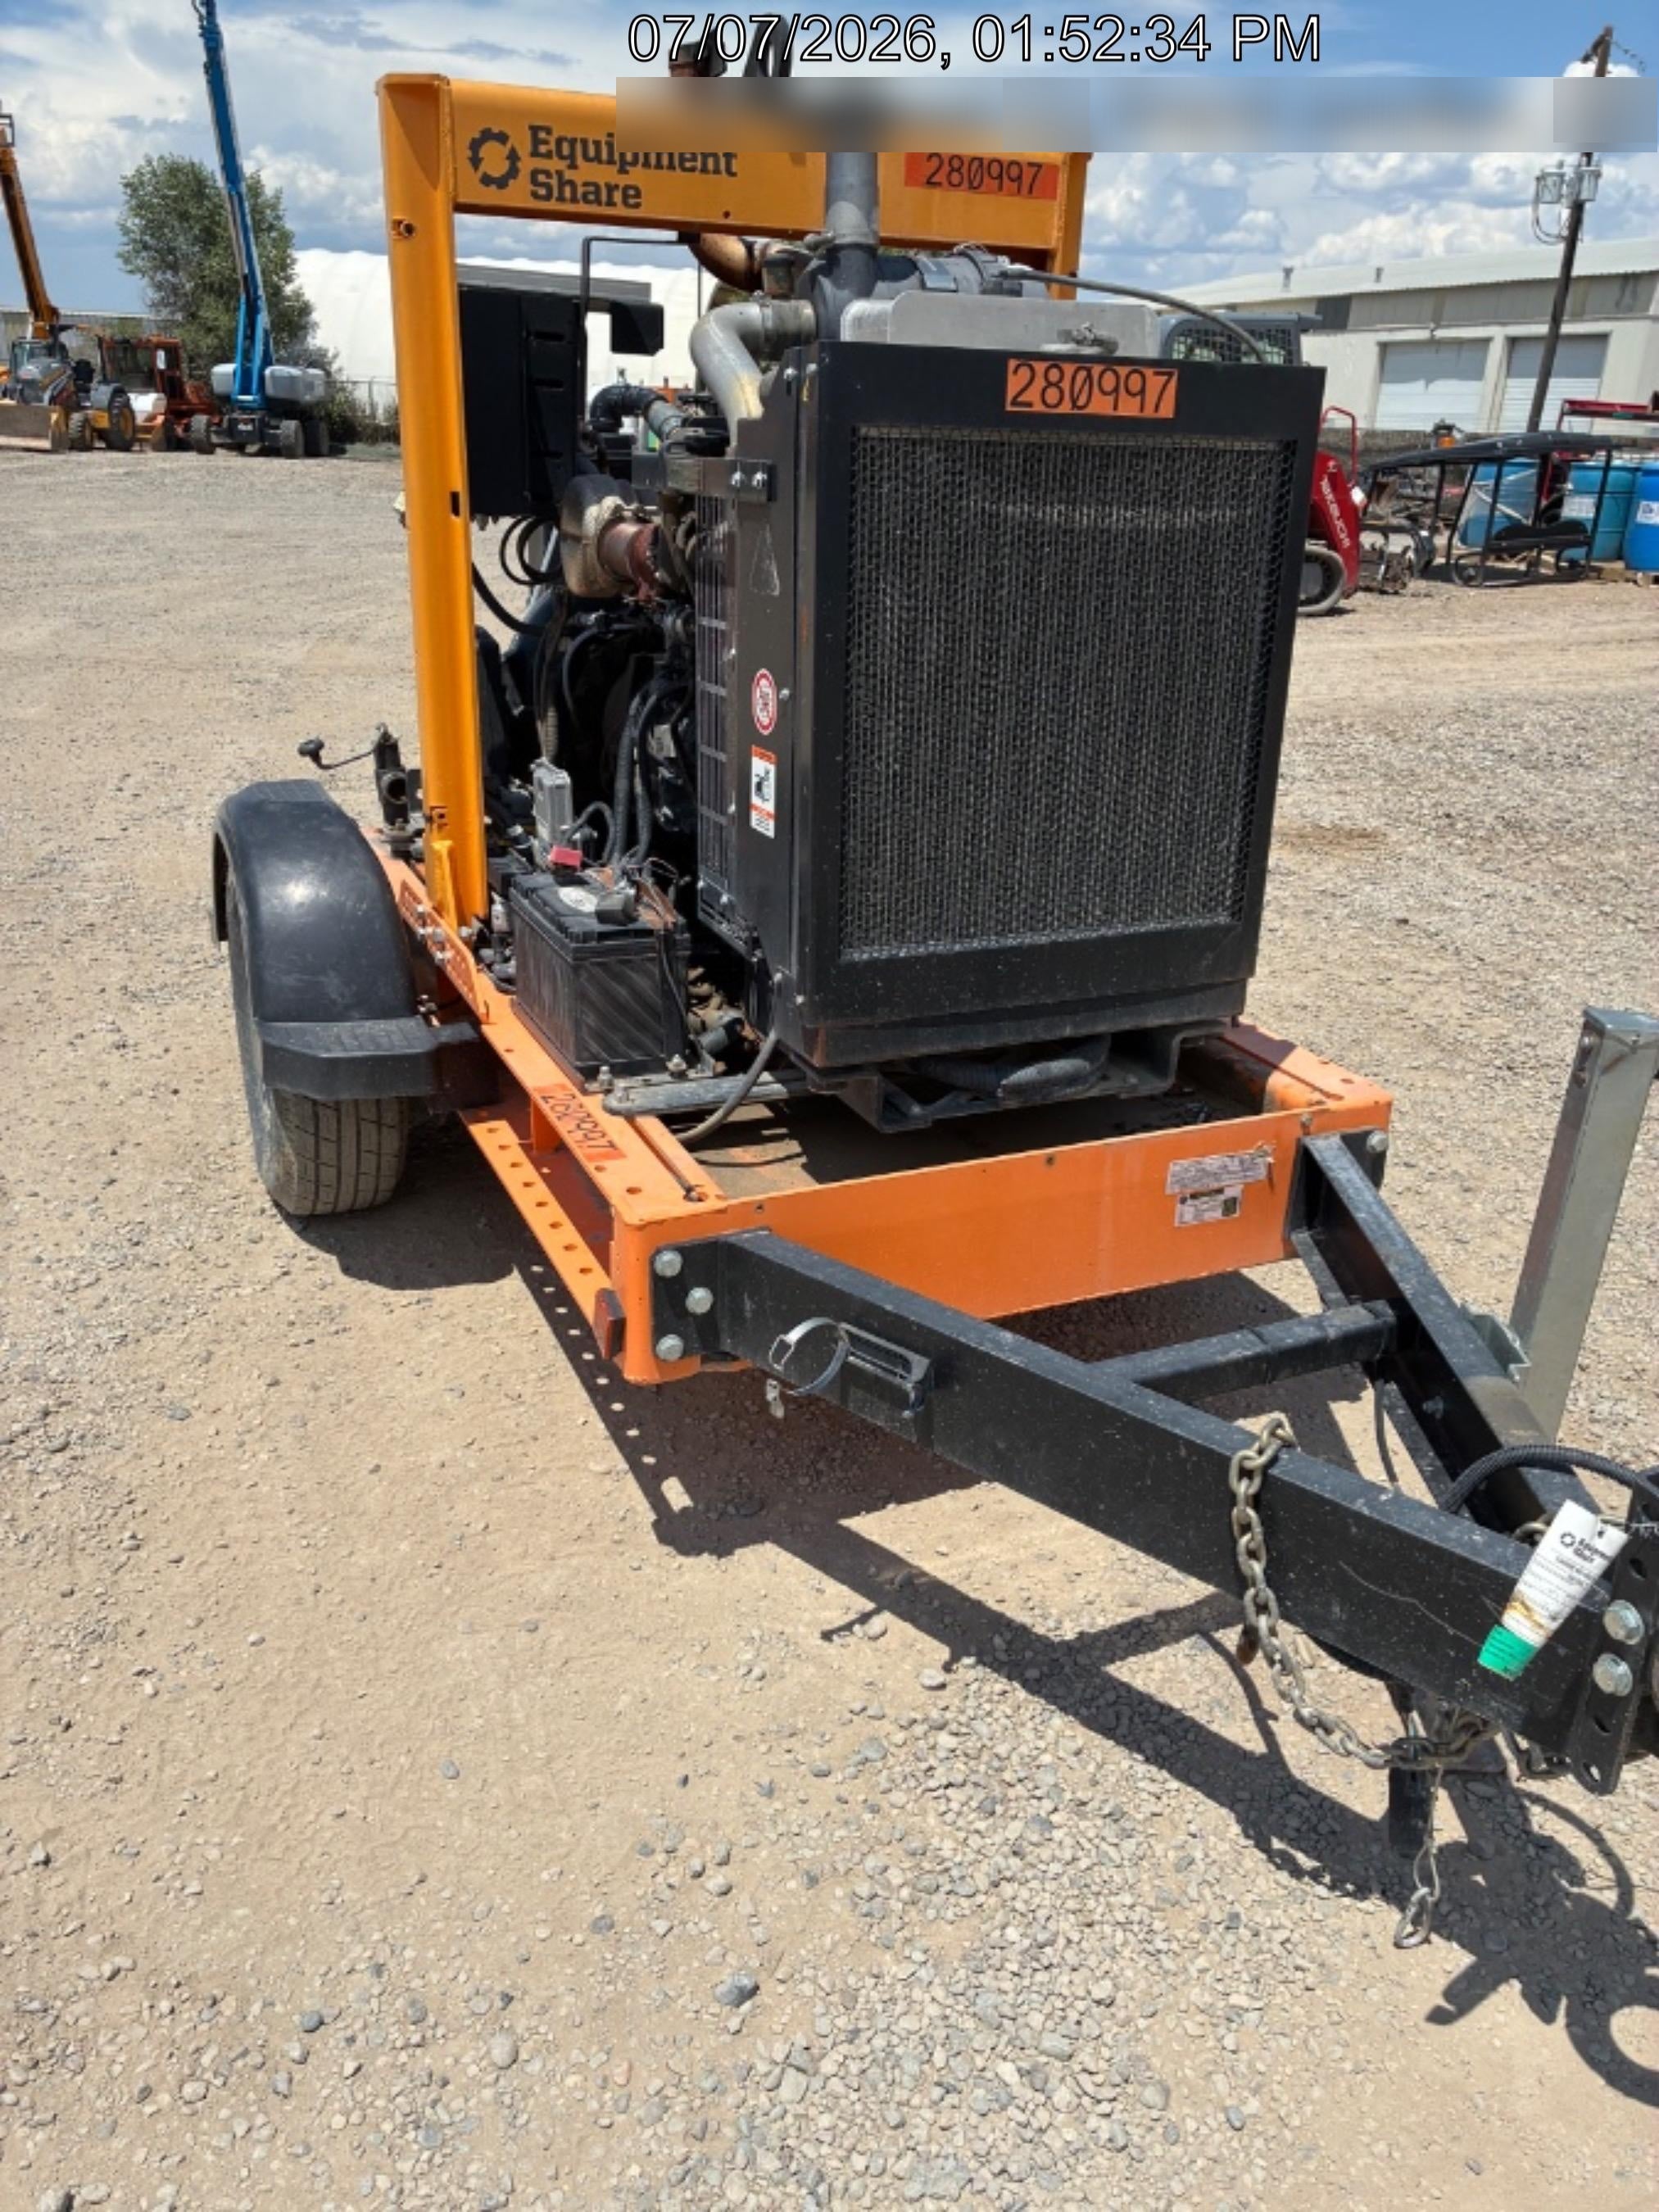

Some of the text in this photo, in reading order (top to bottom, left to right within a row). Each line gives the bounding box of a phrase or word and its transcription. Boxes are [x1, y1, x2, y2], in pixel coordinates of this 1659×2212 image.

[529, 167, 643, 210] Share
[925, 152, 1043, 195] 280997
[1009, 363, 1177, 414] 280997
